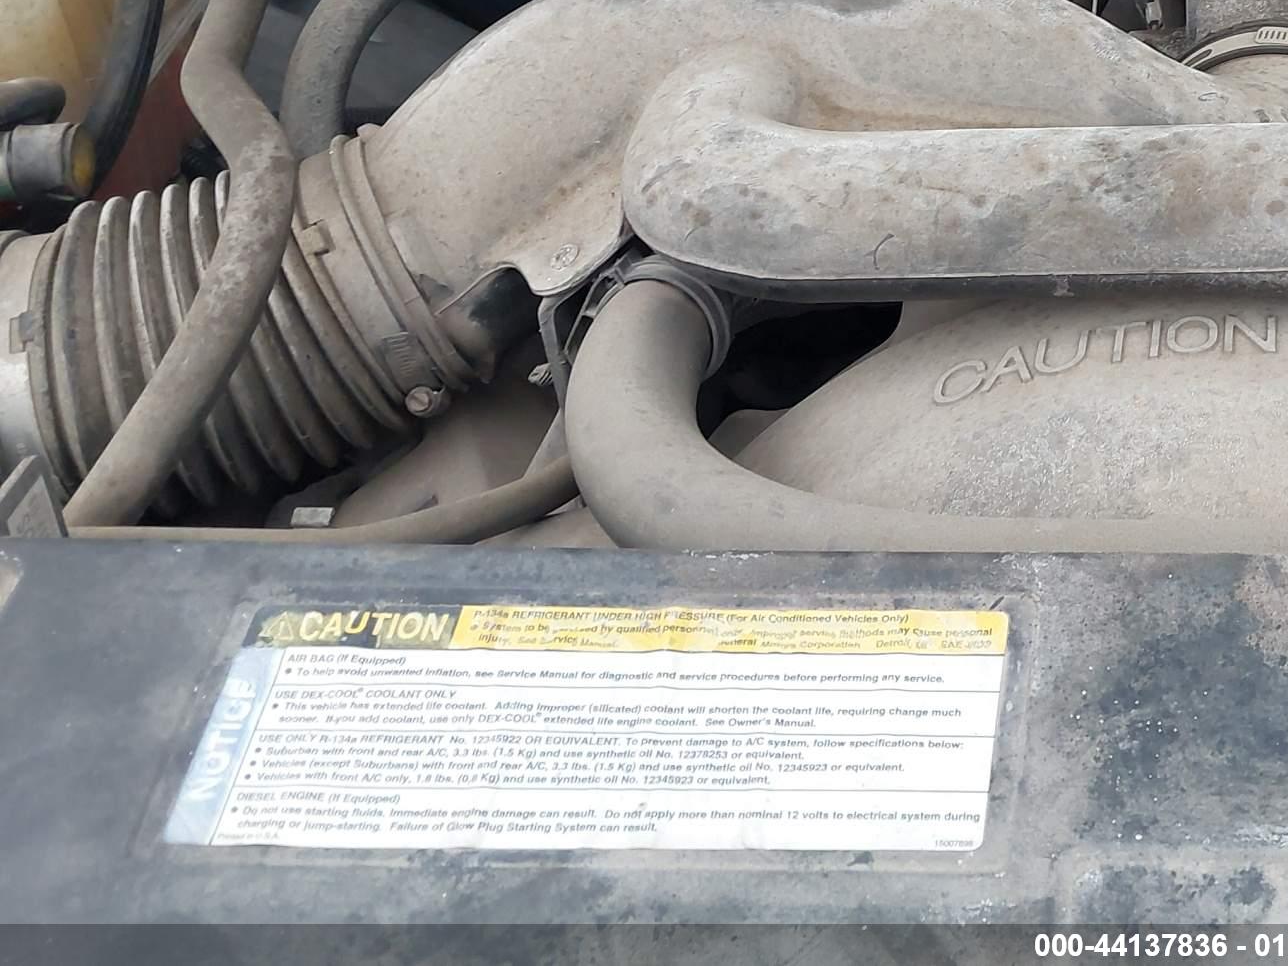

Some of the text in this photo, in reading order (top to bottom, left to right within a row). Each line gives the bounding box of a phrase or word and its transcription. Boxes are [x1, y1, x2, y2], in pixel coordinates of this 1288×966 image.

[932, 314, 1278, 406] CAUTION
[512, 611, 590, 621] REFRIGERANT
[726, 613, 747, 623] (For
[750, 614, 766, 622] Air
[768, 614, 832, 623] Conditioned
[834, 614, 879, 623] Vehicles
[881, 614, 909, 624] Only)
[299, 611, 450, 641] CAUTION
[287, 653, 307, 662] AIR
[309, 654, 334, 663] BAG
[350, 653, 406, 666] Equipped)
[297, 667, 944, 683] To help avoid unwanted inflation, see Service Manual for diagnostic and service procedures before performing any service.
[274, 690, 298, 699] USE
[365, 689, 422, 698] COOLANT
[424, 689, 456, 699] ONLY
[285, 700, 961, 718] This vehicle has extended life coolant. Adding improper (silicated) coolant will shorten the coolant life, requiring change much
[258, 734, 283, 743] USE
[285, 734, 318, 743] ONLY
[359, 734, 444, 744] REFRIGERANT
[524, 735, 542, 745] OR
[544, 735, 620, 746] EQUIVALENT.
[625, 737, 638, 746] To
[640, 737, 683, 746] prevent
[685, 737, 728, 749] damage
[731, 738, 742, 746] to
[745, 736, 764, 746] A/C
[767, 739, 809, 749] system,
[812, 738, 846, 747] follow
[849, 738, 924, 748] specifications
[236, 792, 274, 801] DIESEL
[280, 791, 324, 801] ENGINE
[342, 793, 400, 805] Equipped)
[304, 807, 349, 819] starting
[351, 807, 384, 817] fluids.
[389, 808, 448, 817] Immediate
[450, 807, 489, 818] engine
[490, 809, 536, 820] damage
[538, 810, 560, 818] can
[562, 809, 596, 818] result.
[604, 809, 620, 818] Do
[622, 809, 643, 819] not
[643, 809, 675, 821] apply
[677, 811, 707, 819] more
[710, 809, 735, 819] than
[737, 809, 783, 819] nominal
[787, 810, 799, 819] 12
[801, 810, 829, 819] volts
[832, 811, 844, 819] to
[846, 810, 898, 820] electrical
[900, 811, 941, 822] system
[943, 811, 980, 823] during
[237, 819, 286, 829] charging
[389, 821, 429, 831] Failure
[431, 822, 444, 831] of
[446, 821, 475, 831] Glow
[476, 821, 504, 834] Plug
[506, 822, 552, 834] Starting
[554, 822, 597, 834] System
[599, 824, 620, 832] can
[622, 821, 657, 832] result.
